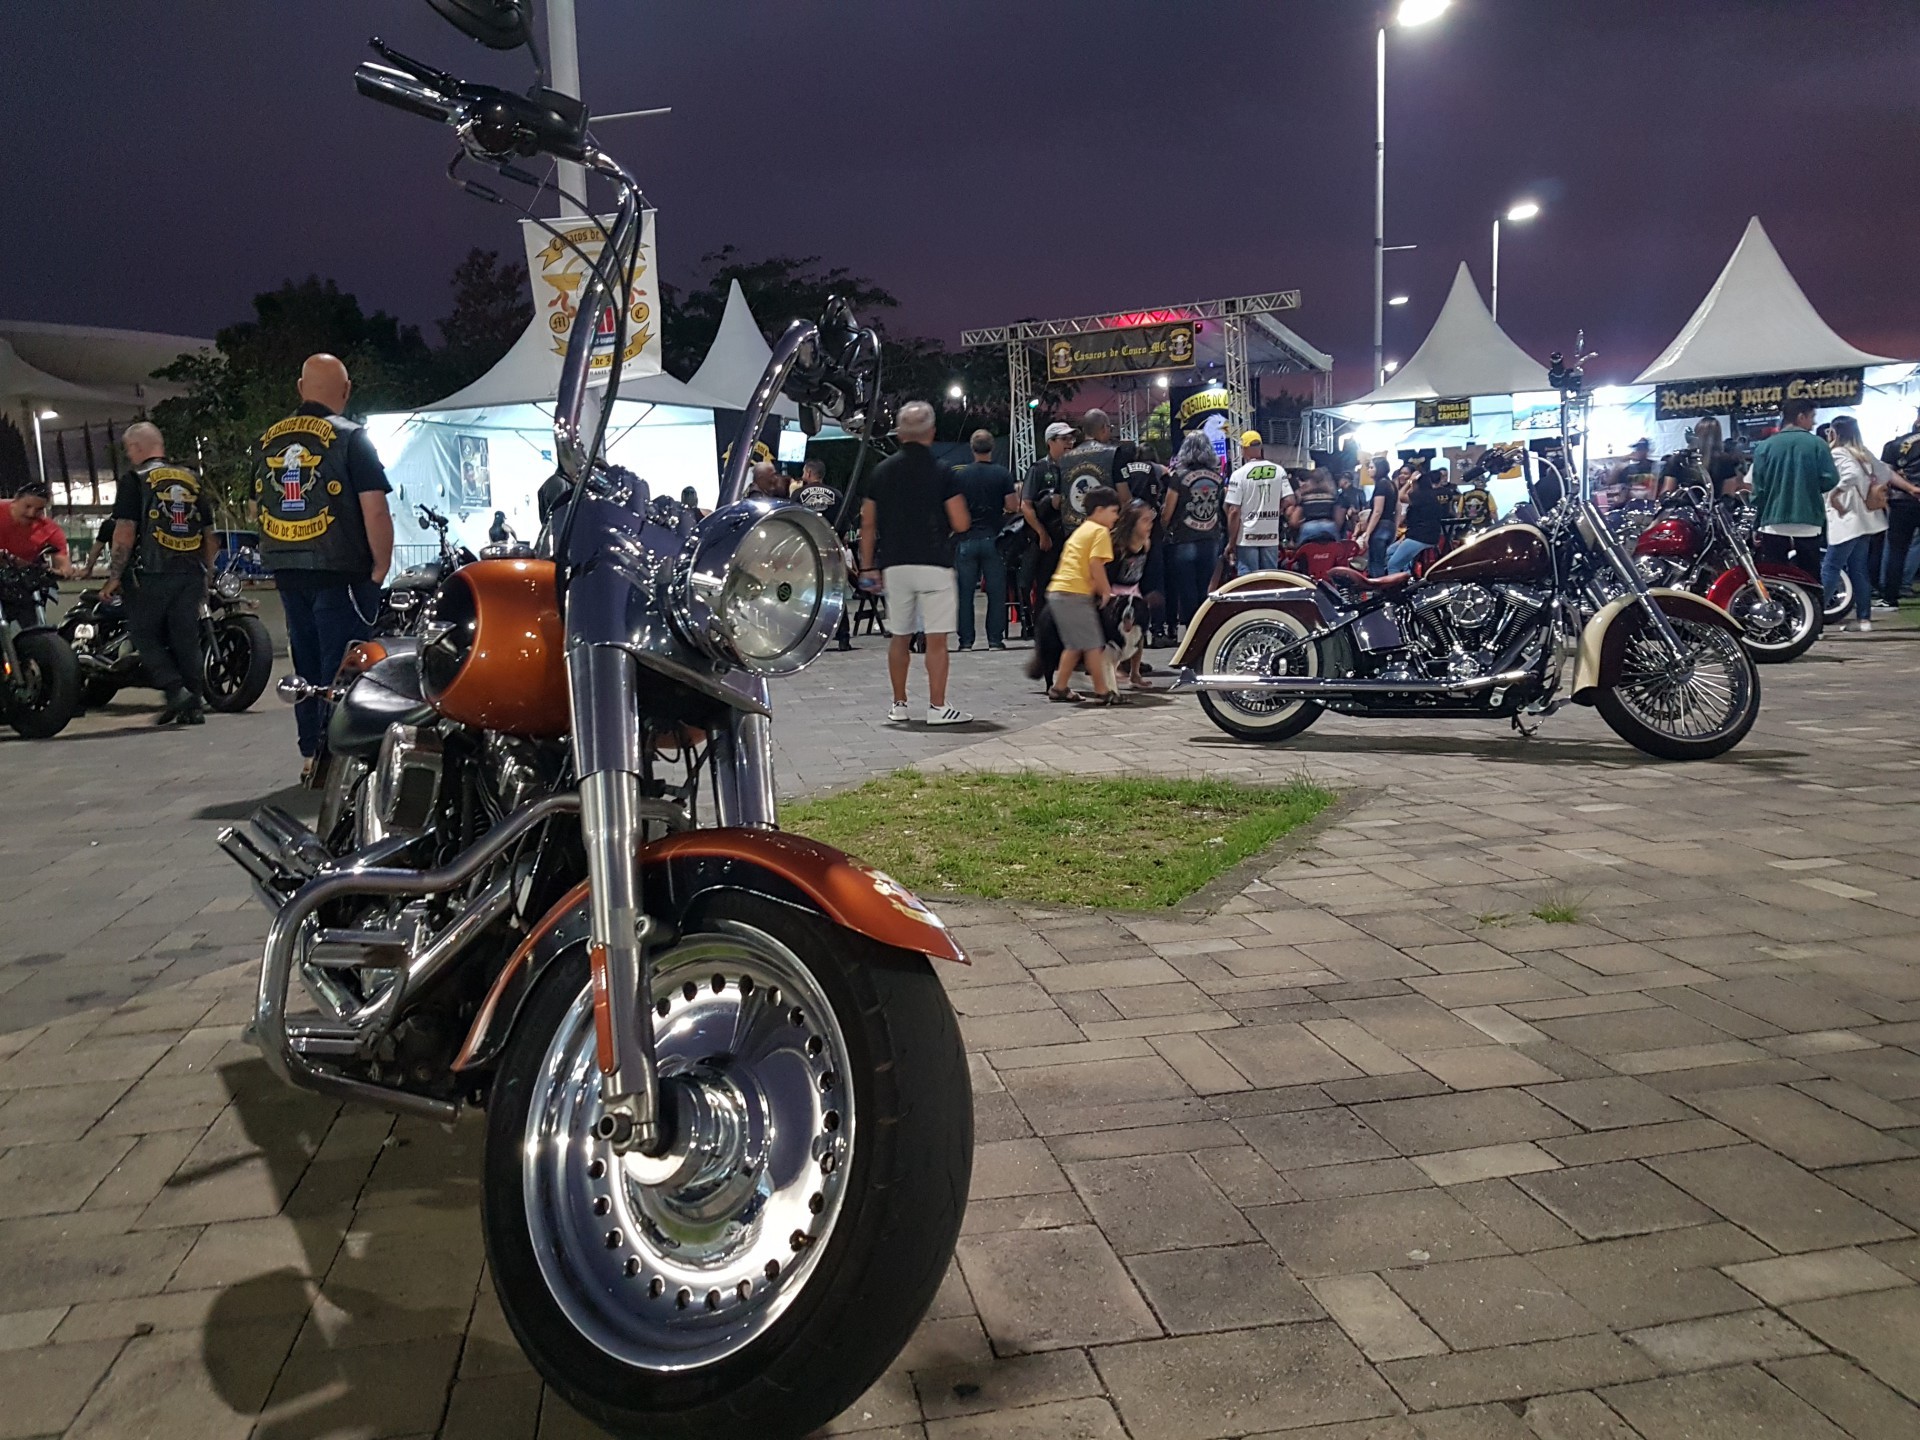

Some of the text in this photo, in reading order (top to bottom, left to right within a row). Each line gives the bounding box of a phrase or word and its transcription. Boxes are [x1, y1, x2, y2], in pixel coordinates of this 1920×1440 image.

[552, 229, 600, 251] Cacos de
[1073, 350, 1107, 362] Casacos
[1109, 347, 1119, 358] de
[1121, 345, 1147, 357] Couro
[1661, 375, 1859, 410] Resistir para Existir
[1438, 402, 1469, 411] VENDA DE
[1438, 411, 1469, 420] CAMISAS
[1246, 465, 1277, 480] 46
[266, 520, 324, 538] Rio de Janeiro
